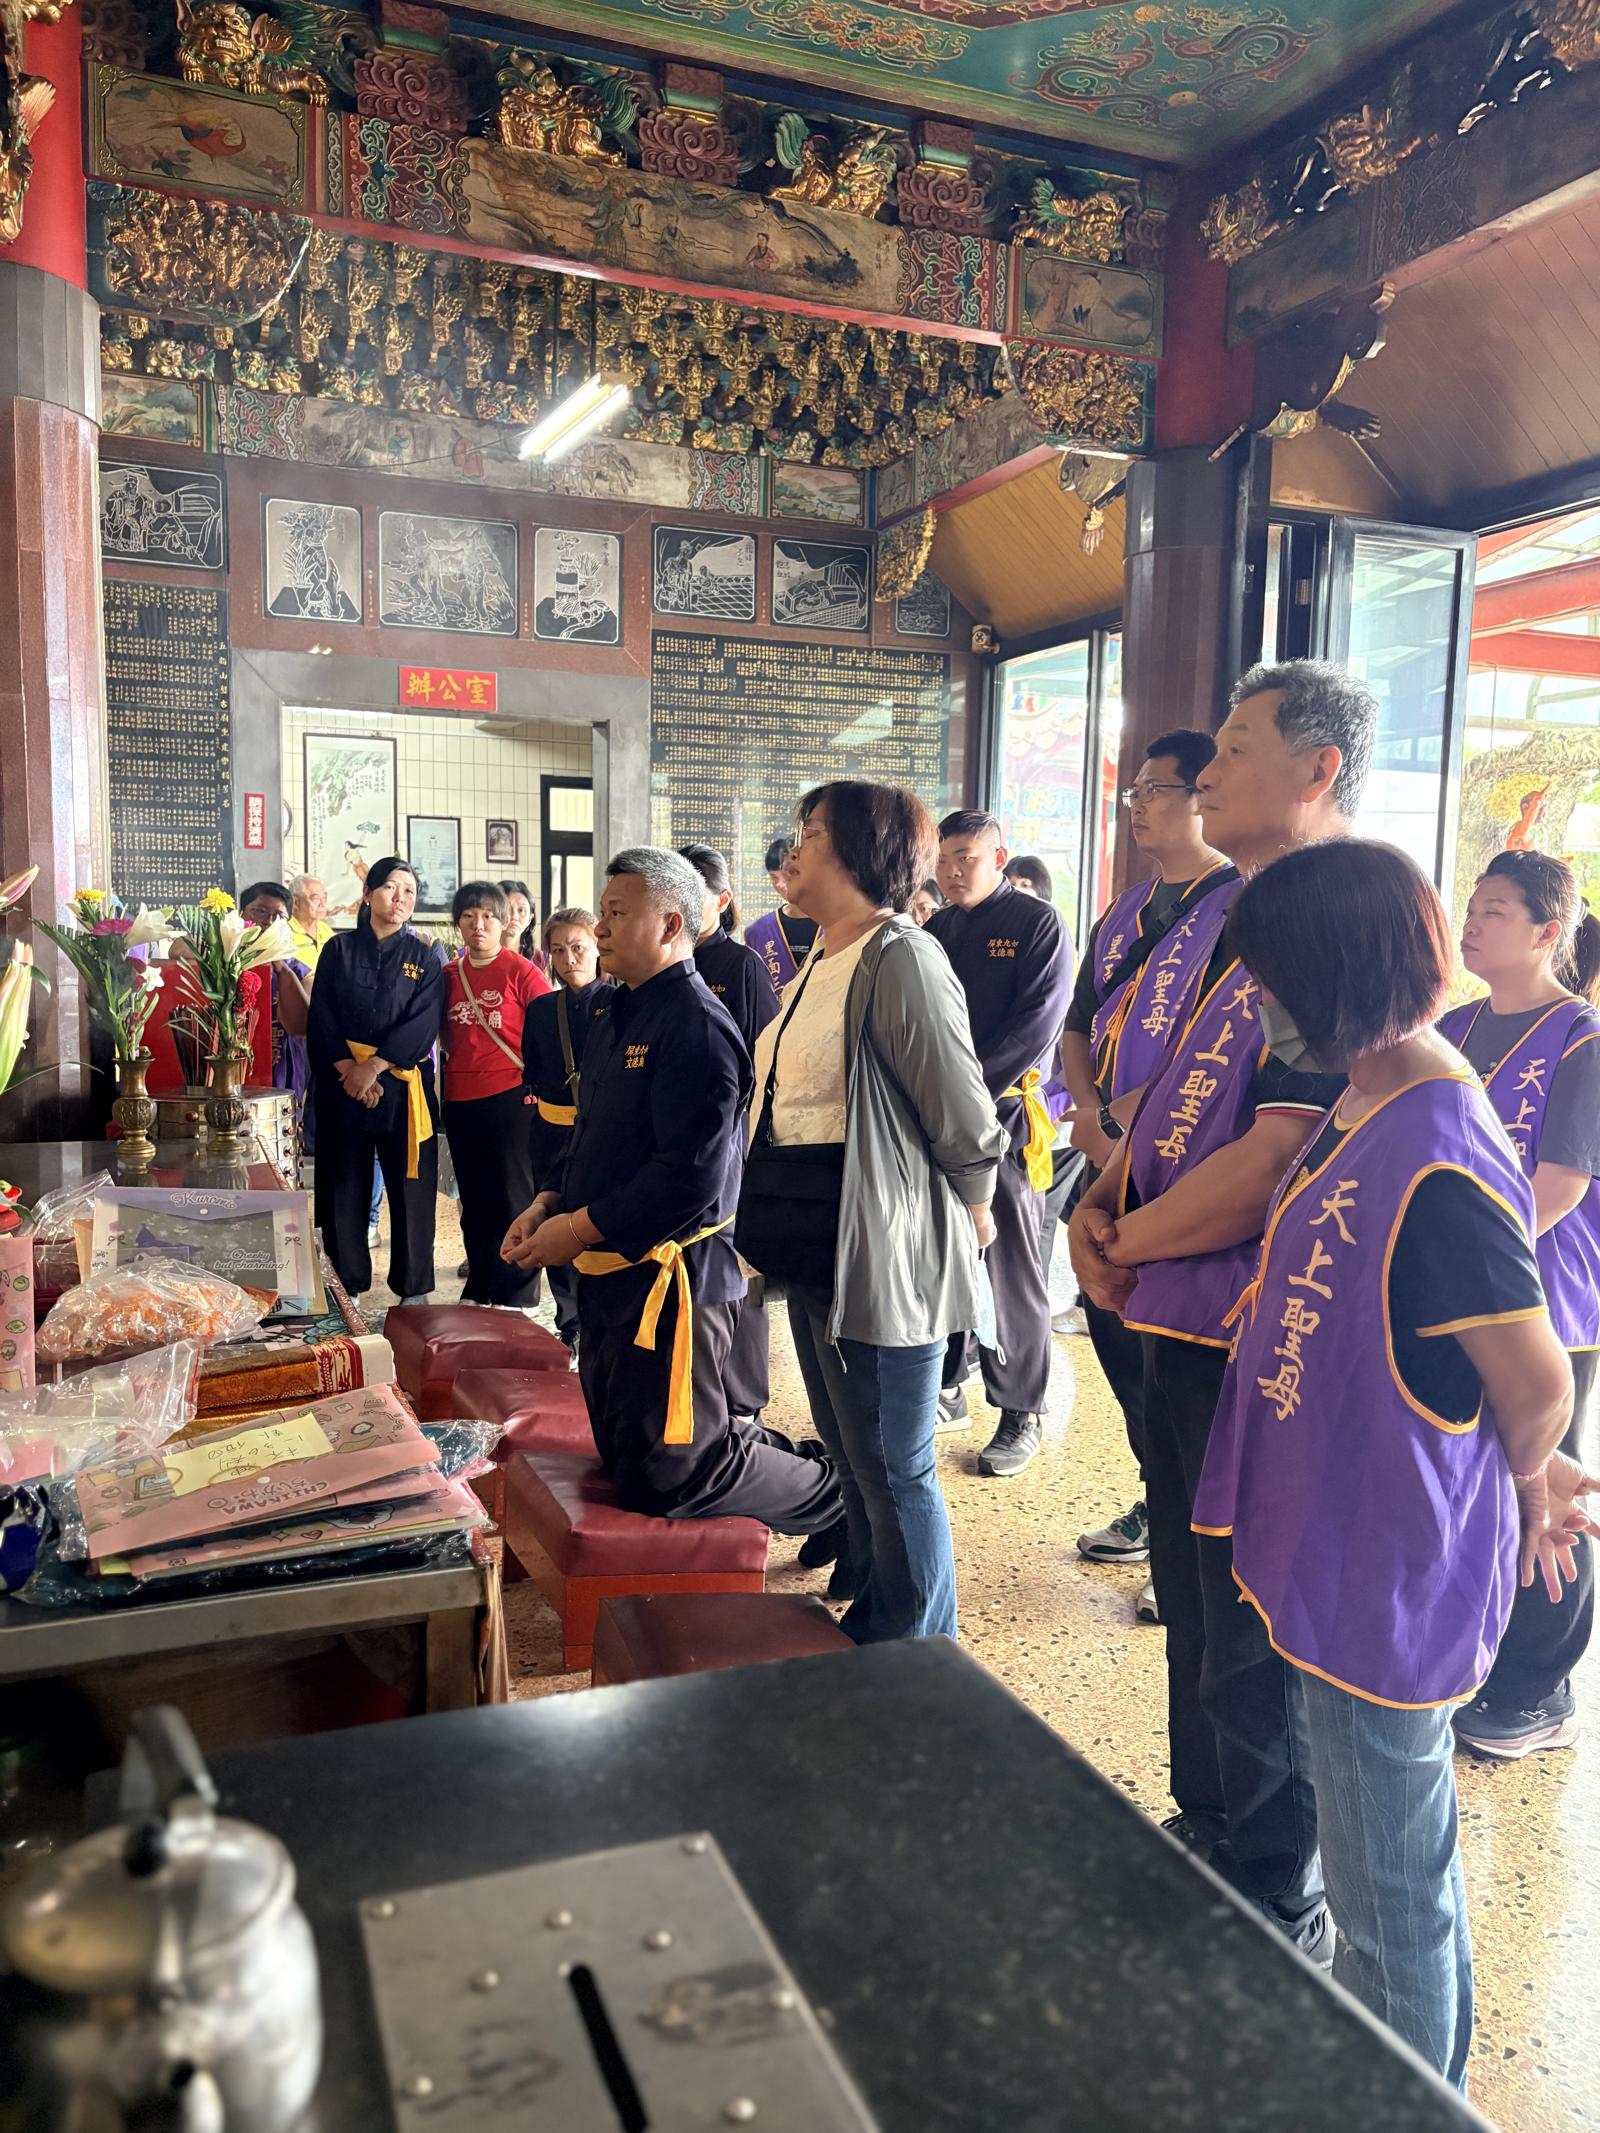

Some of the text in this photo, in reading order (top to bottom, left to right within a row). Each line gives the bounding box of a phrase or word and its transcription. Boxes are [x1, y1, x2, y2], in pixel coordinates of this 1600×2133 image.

[1140, 910, 1200, 1038] 天上聖母
[1154, 976, 1259, 1166] 天上聖母
[214, 1259, 289, 1271] but charming!
[230, 1248, 271, 1261] Cheeky
[1257, 1179, 1359, 1421] 天上聖母
[222, 1481, 328, 1515] CHIIKAWA
